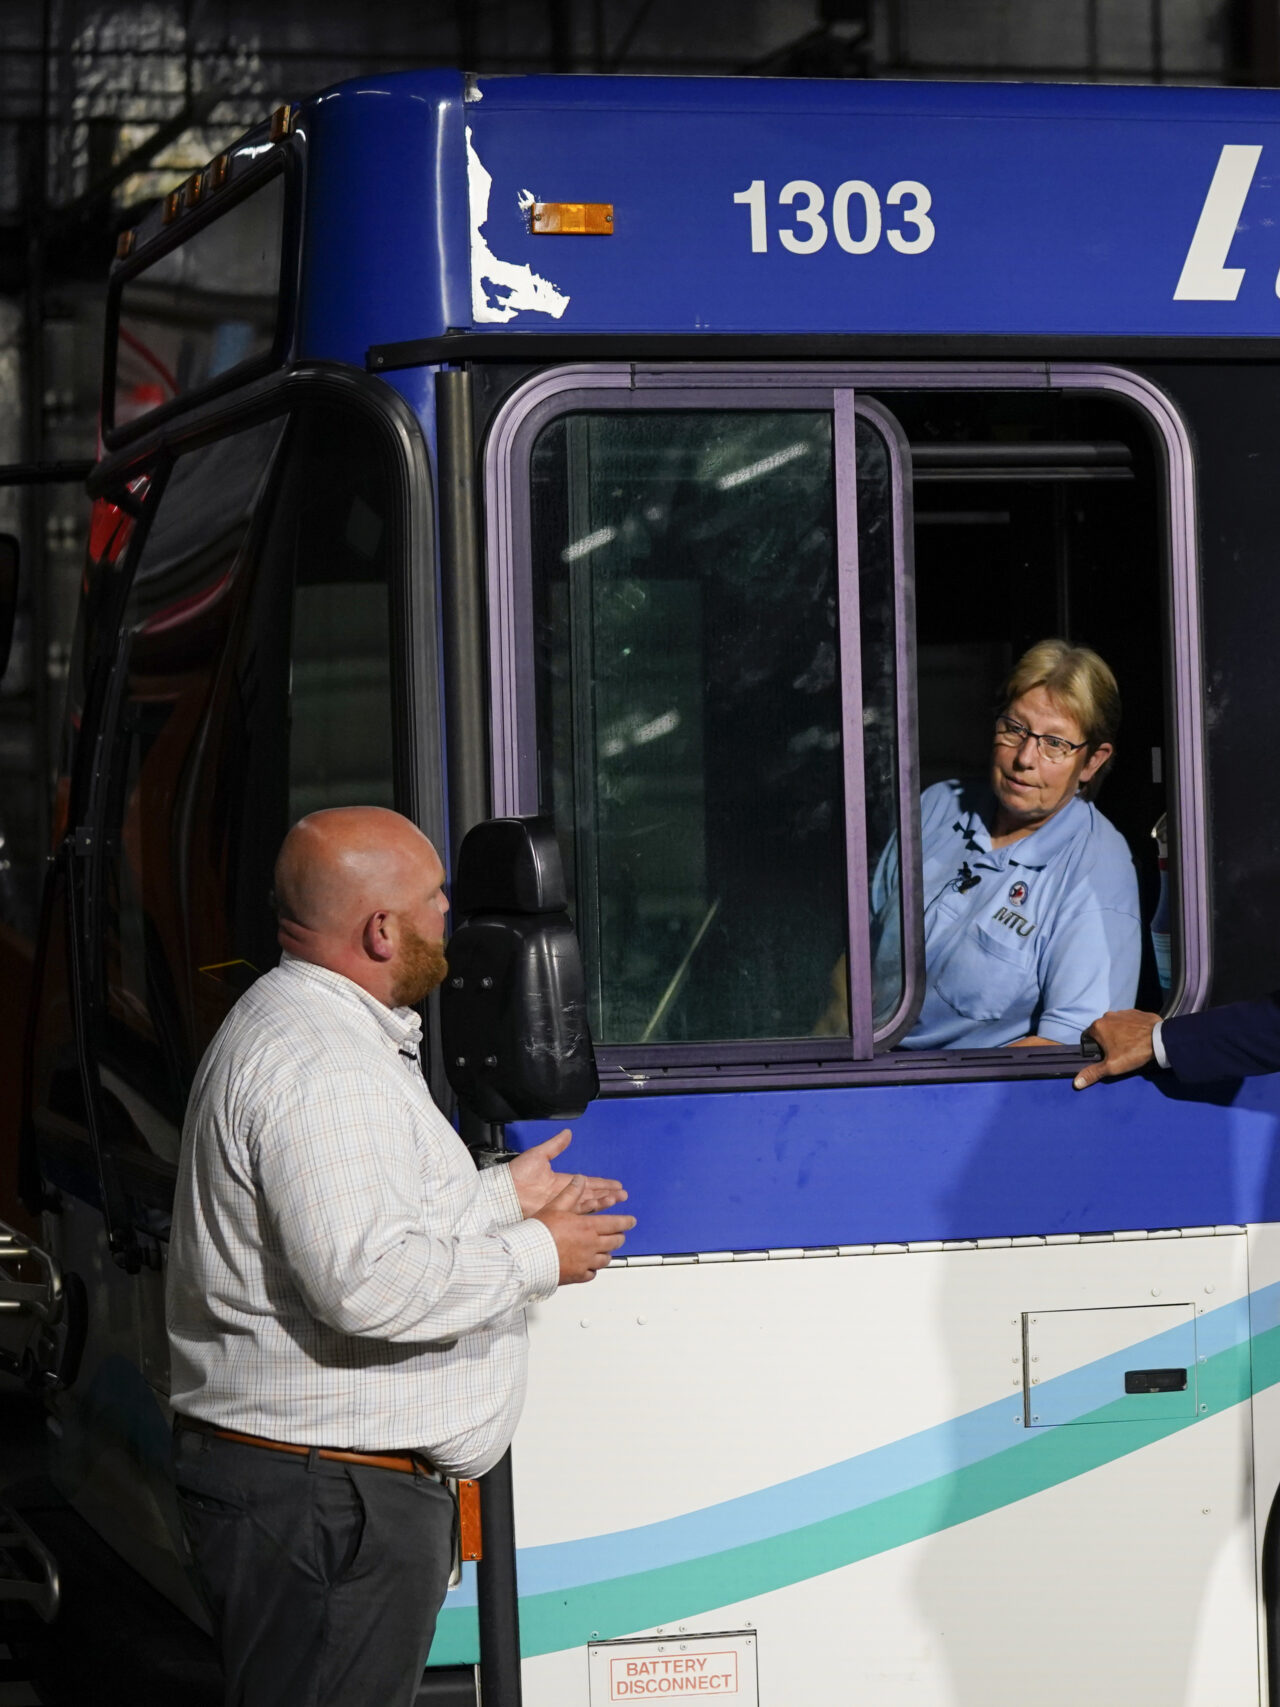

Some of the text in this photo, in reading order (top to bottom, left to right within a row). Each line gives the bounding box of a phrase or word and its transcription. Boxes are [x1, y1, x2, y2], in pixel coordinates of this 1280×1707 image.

[733, 179, 936, 256] 1303
[991, 906, 1036, 937] MTU
[626, 1658, 707, 1677] BATTERY
[616, 1674, 732, 1695] DISCONNECT
